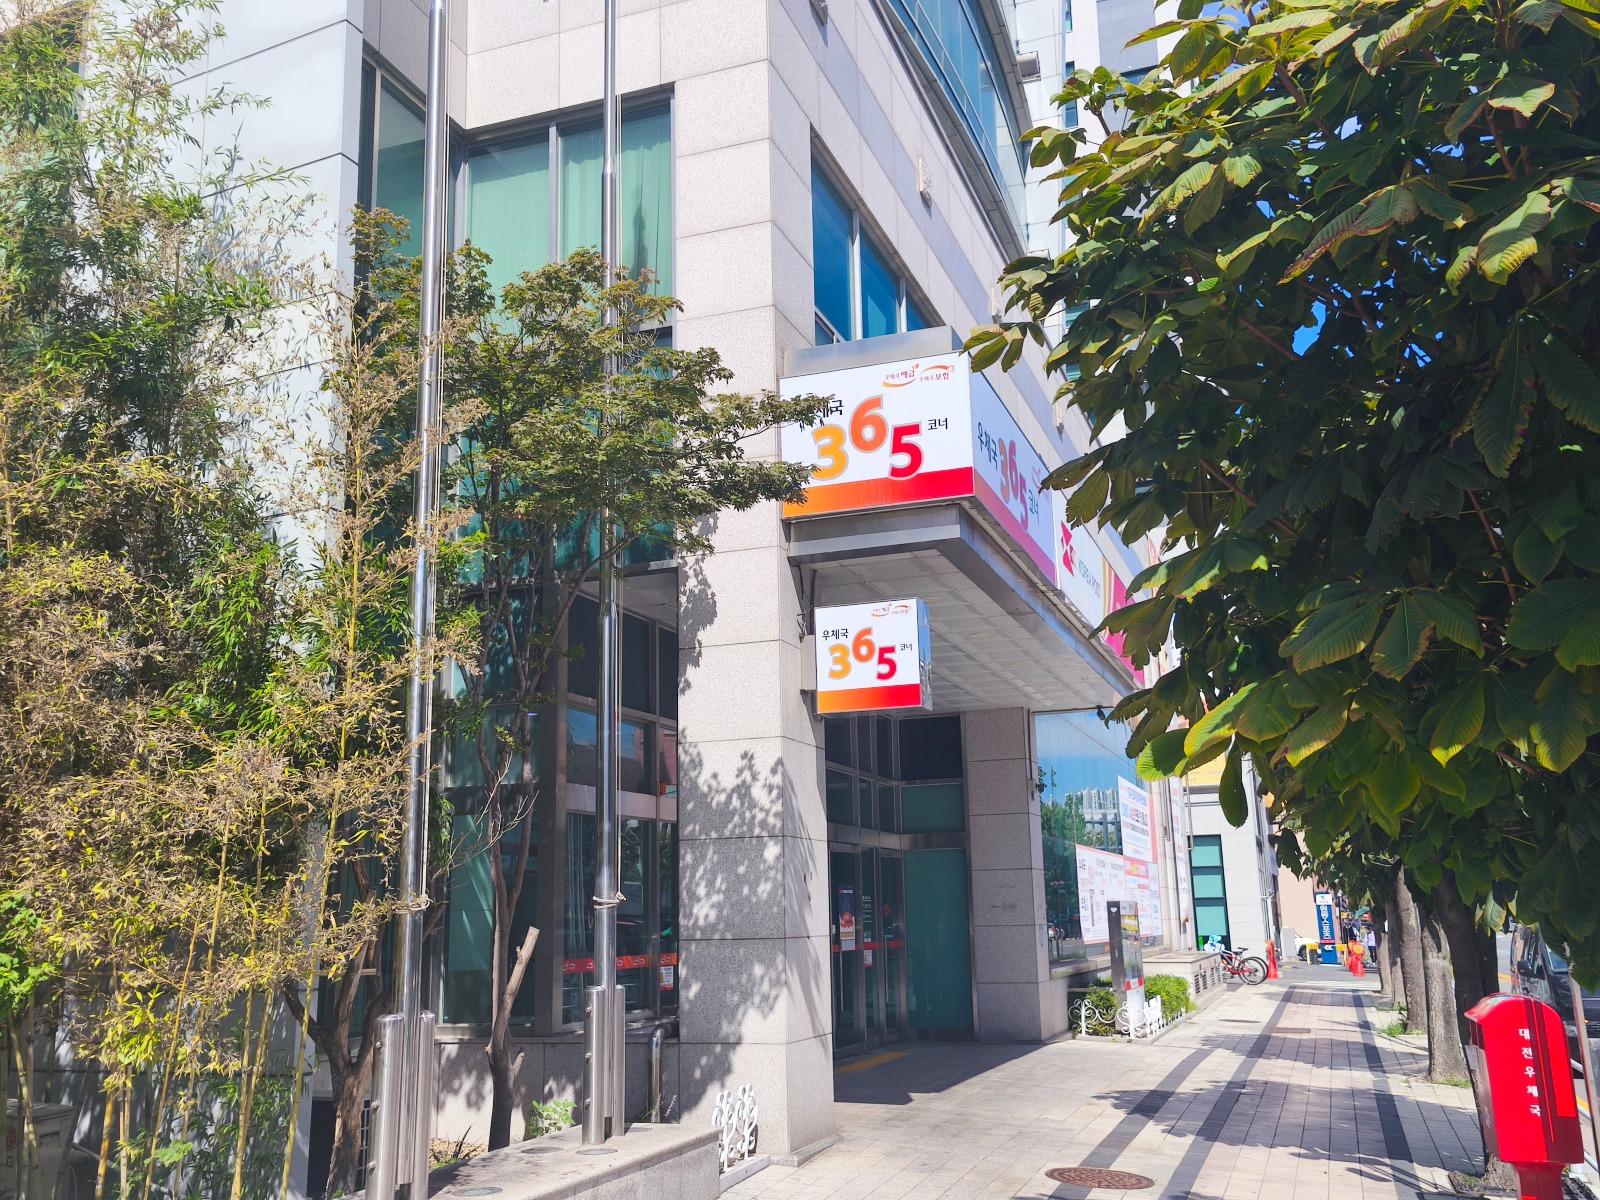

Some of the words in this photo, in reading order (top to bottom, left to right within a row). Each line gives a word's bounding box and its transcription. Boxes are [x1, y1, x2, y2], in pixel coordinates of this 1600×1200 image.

[901, 369, 915, 379] 예금
[936, 371, 950, 381] 보험
[811, 394, 924, 480] 365
[927, 417, 949, 430] 코너
[978, 421, 998, 471] 우체국
[997, 437, 1029, 532] 365
[1028, 488, 1041, 526] 코너
[821, 628, 849, 641] 우체국
[899, 643, 913, 651] 코너
[828, 626, 898, 682] 365
[1518, 1028, 1541, 1117] 대전우체국
